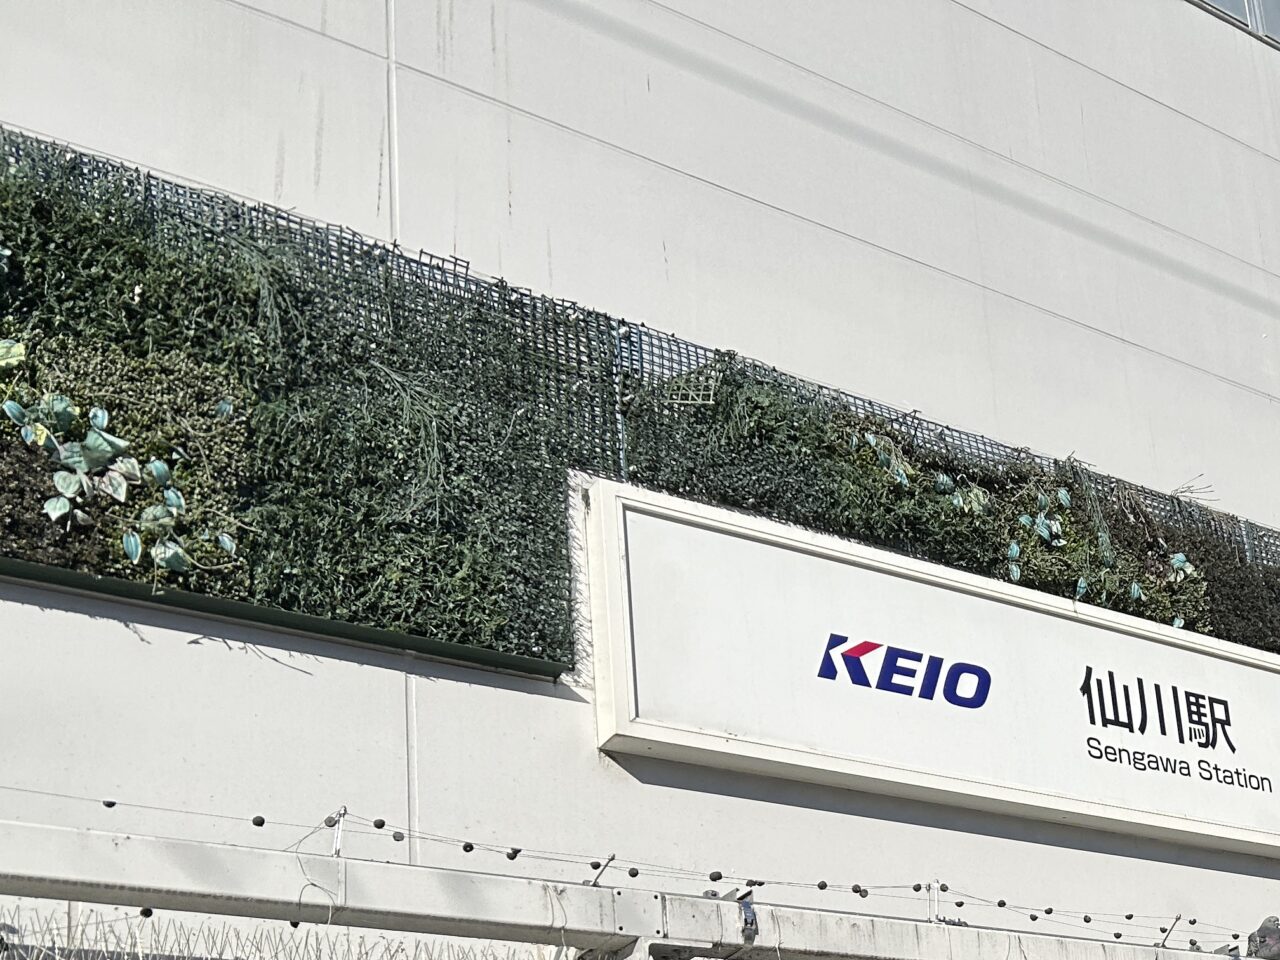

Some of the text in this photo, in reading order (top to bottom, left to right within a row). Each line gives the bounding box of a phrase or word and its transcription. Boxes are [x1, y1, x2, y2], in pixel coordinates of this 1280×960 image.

[817, 633, 993, 710] KEIO
[1079, 664, 1238, 756] 仙川駅
[1086, 736, 1274, 794] Sengawa Station
